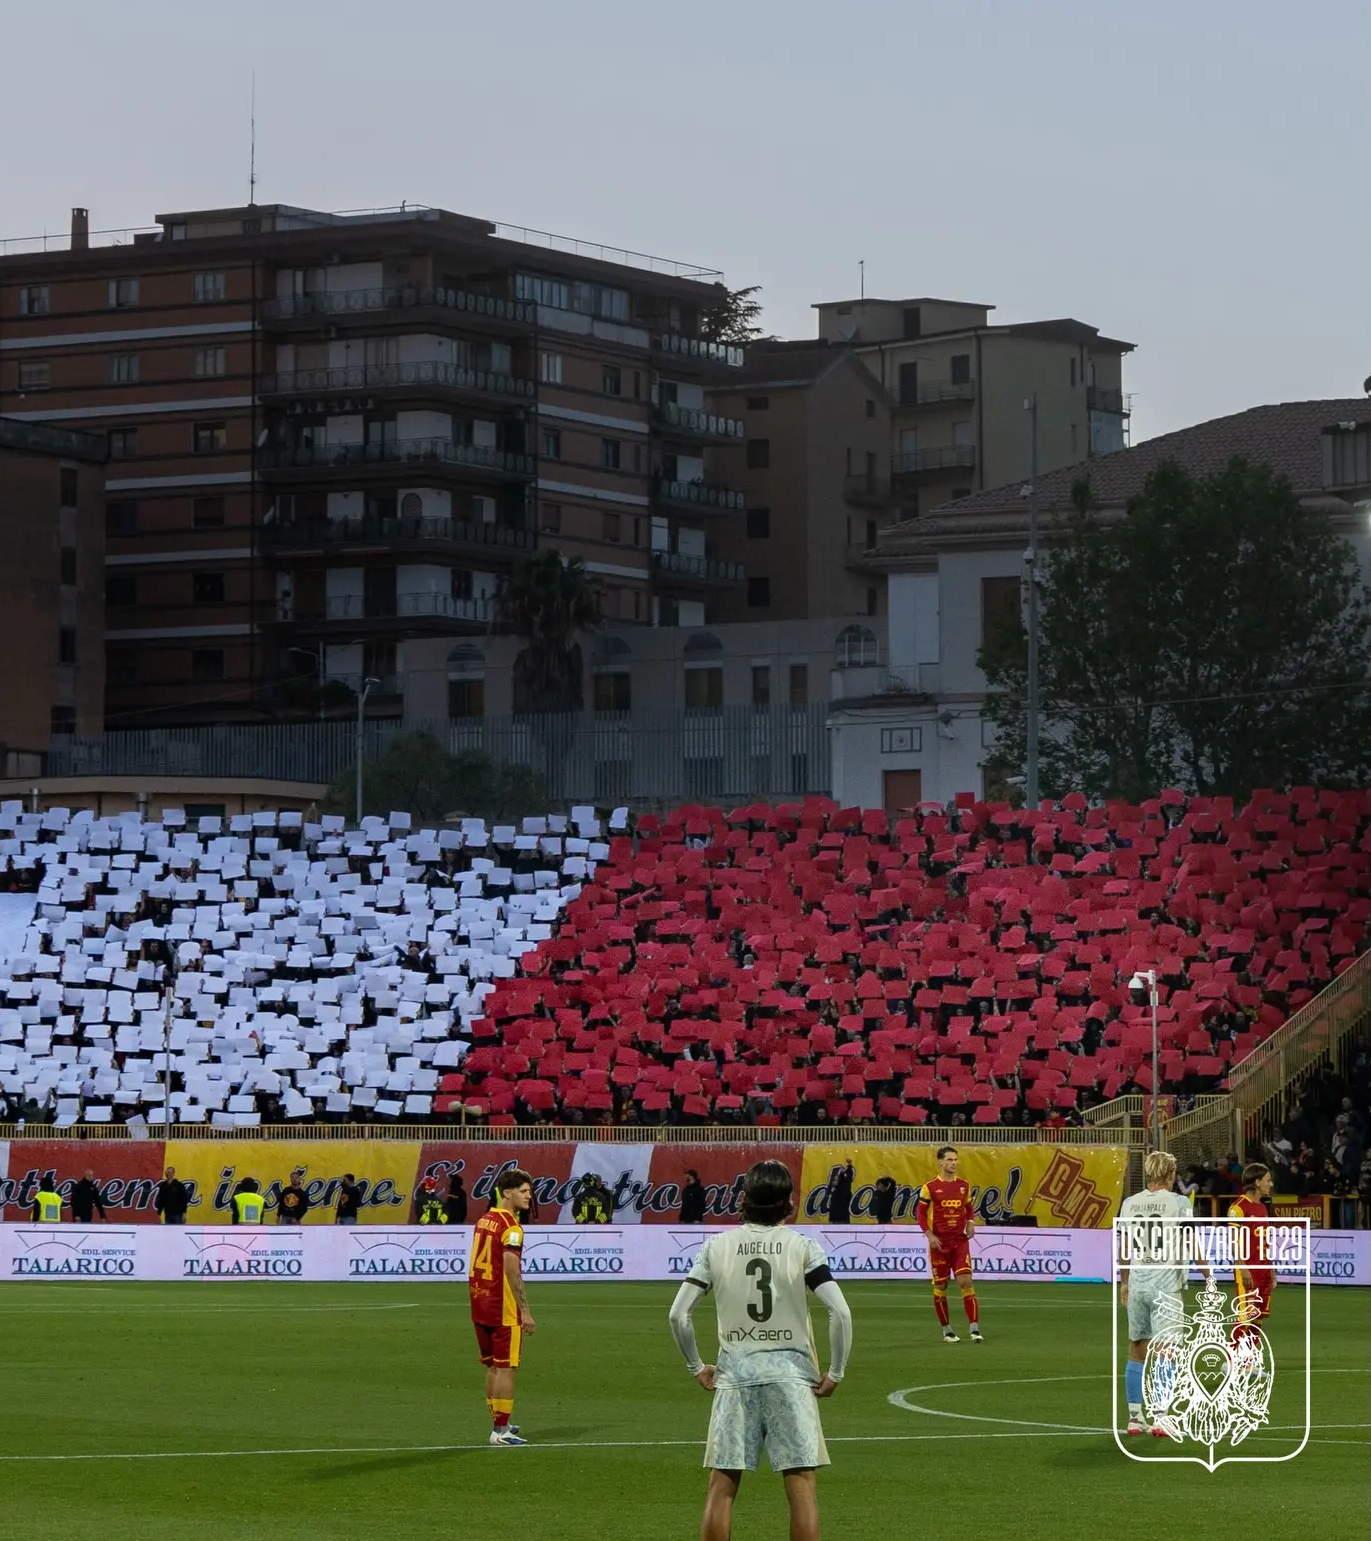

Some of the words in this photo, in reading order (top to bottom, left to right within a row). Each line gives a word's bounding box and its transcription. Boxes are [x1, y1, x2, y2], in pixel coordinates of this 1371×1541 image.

[532, 1169, 683, 1214] notro
[941, 1200, 962, 1208] coop
[469, 1232, 494, 1280] 14
[737, 1241, 783, 1256] AUGELLO
[12, 1257, 134, 1274] TALARICO
[183, 1259, 302, 1275] TALARICO
[349, 1258, 466, 1274] TALARICO
[828, 1256, 927, 1272] TALARICO
[971, 1257, 1072, 1274] TALARICO
[746, 1257, 773, 1323] 3
